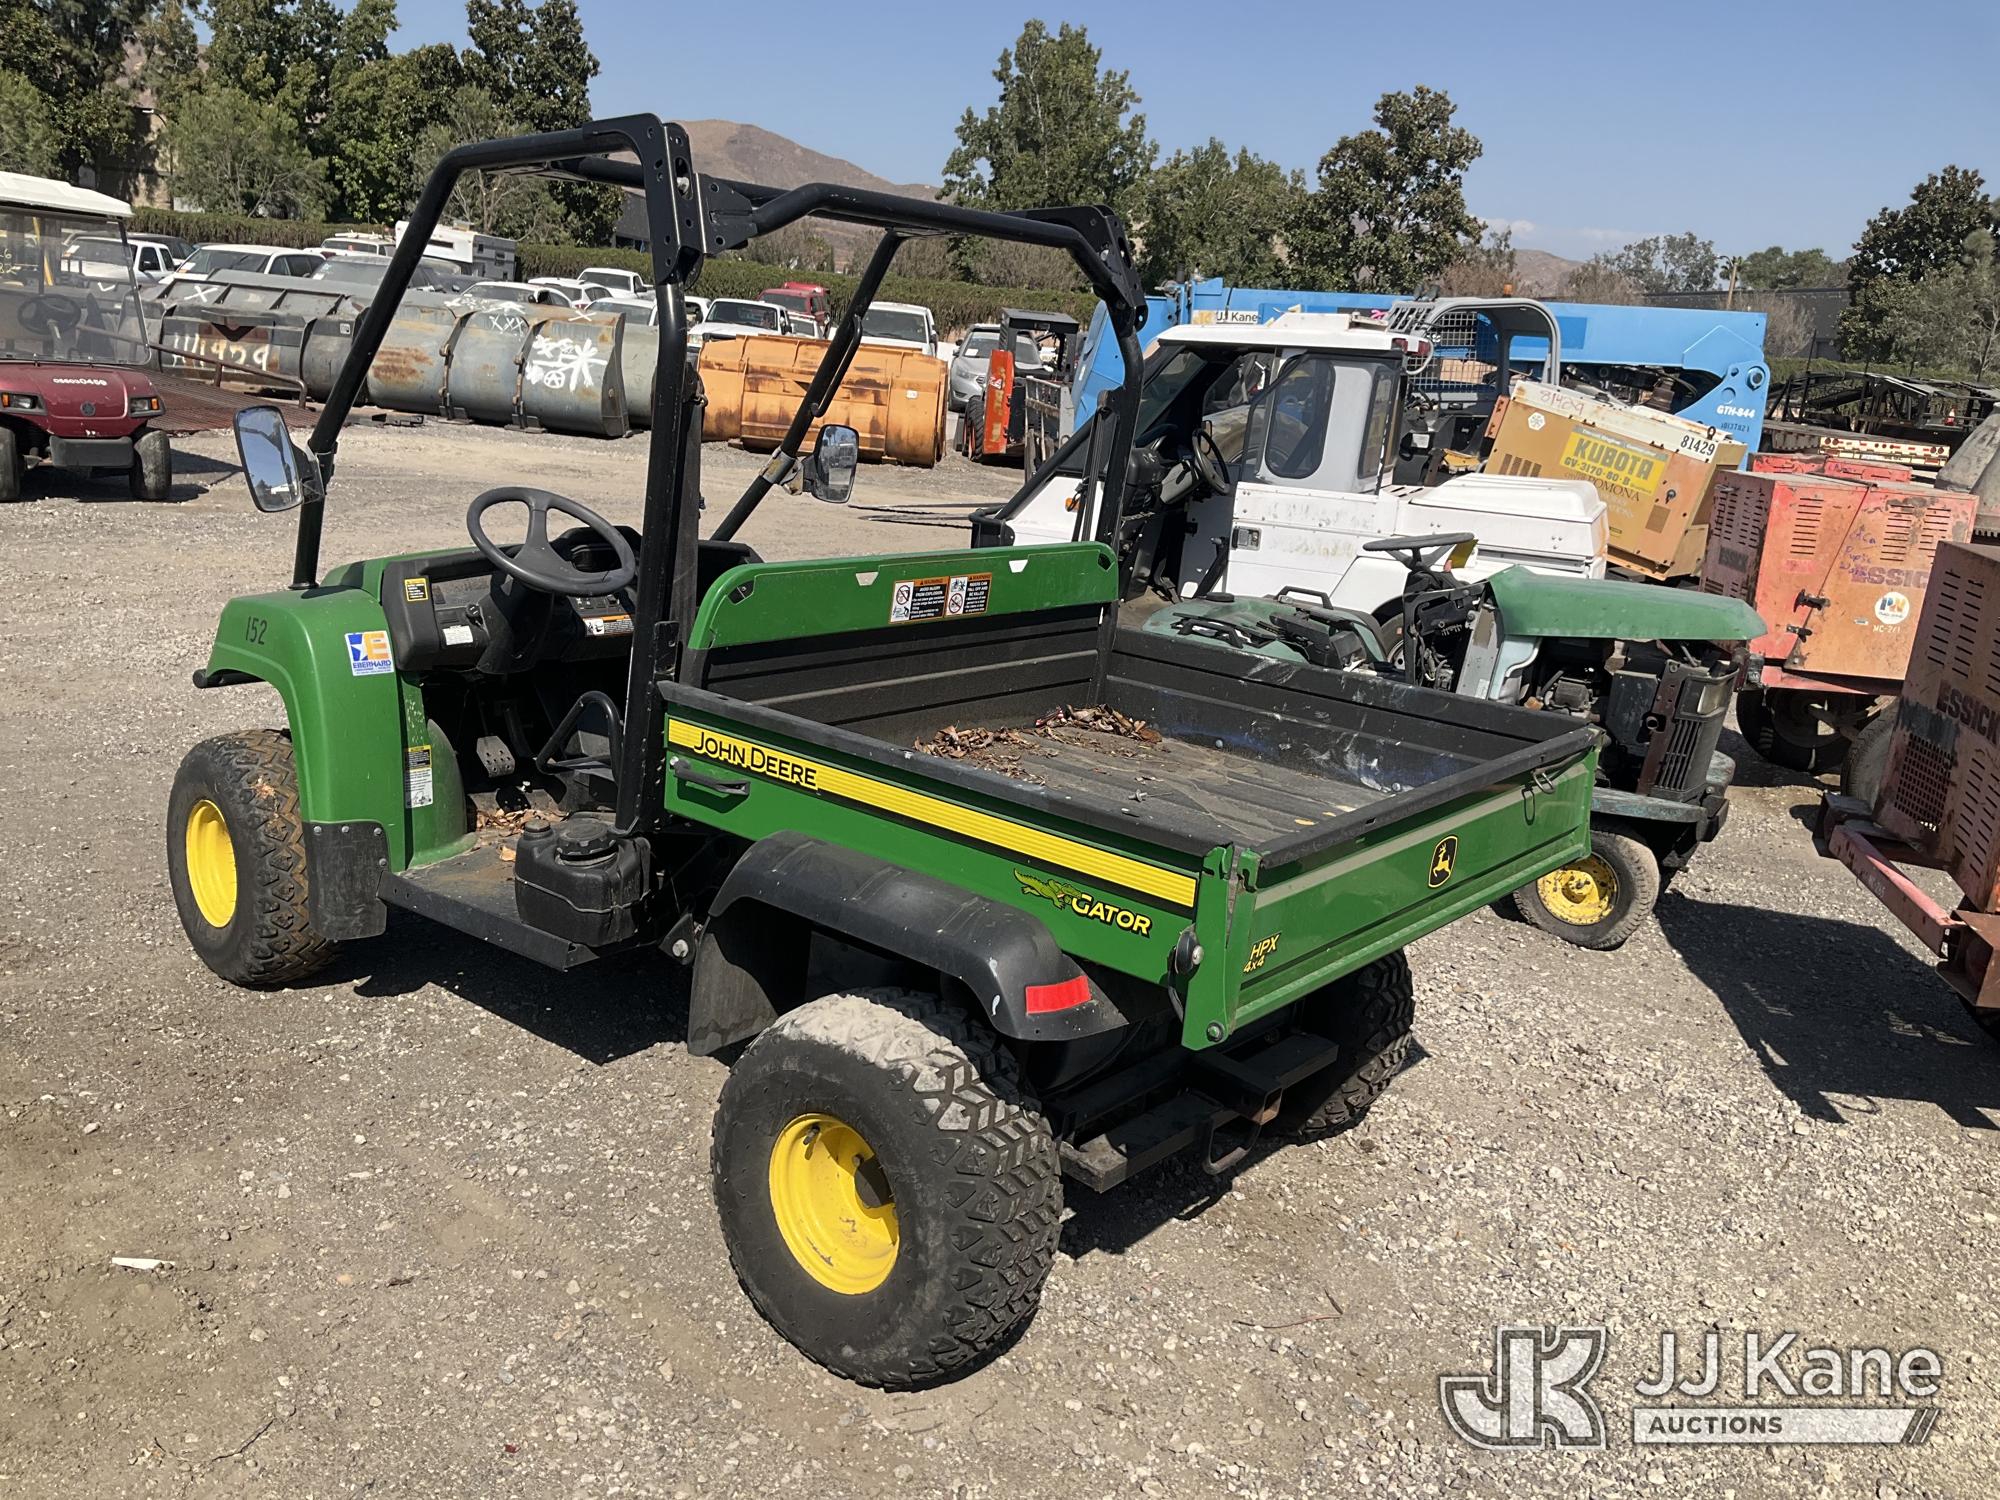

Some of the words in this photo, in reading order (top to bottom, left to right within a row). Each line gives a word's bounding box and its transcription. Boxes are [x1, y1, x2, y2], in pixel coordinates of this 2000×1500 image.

[1231, 311, 1258, 322] Kane
[1716, 404, 1756, 418] GTH-844
[1680, 435, 1716, 456] 81429
[1573, 438, 1655, 480] KUBOTA
[245, 616, 268, 645] 152
[353, 660, 391, 668] EBERHARD
[1936, 680, 2000, 745] ESSICK
[694, 732, 746, 766] JOHN
[751, 748, 817, 788] DEERE
[1071, 893, 1152, 936] GATOR
[1250, 934, 1280, 960] HPX
[1243, 955, 1265, 973] 4x4
